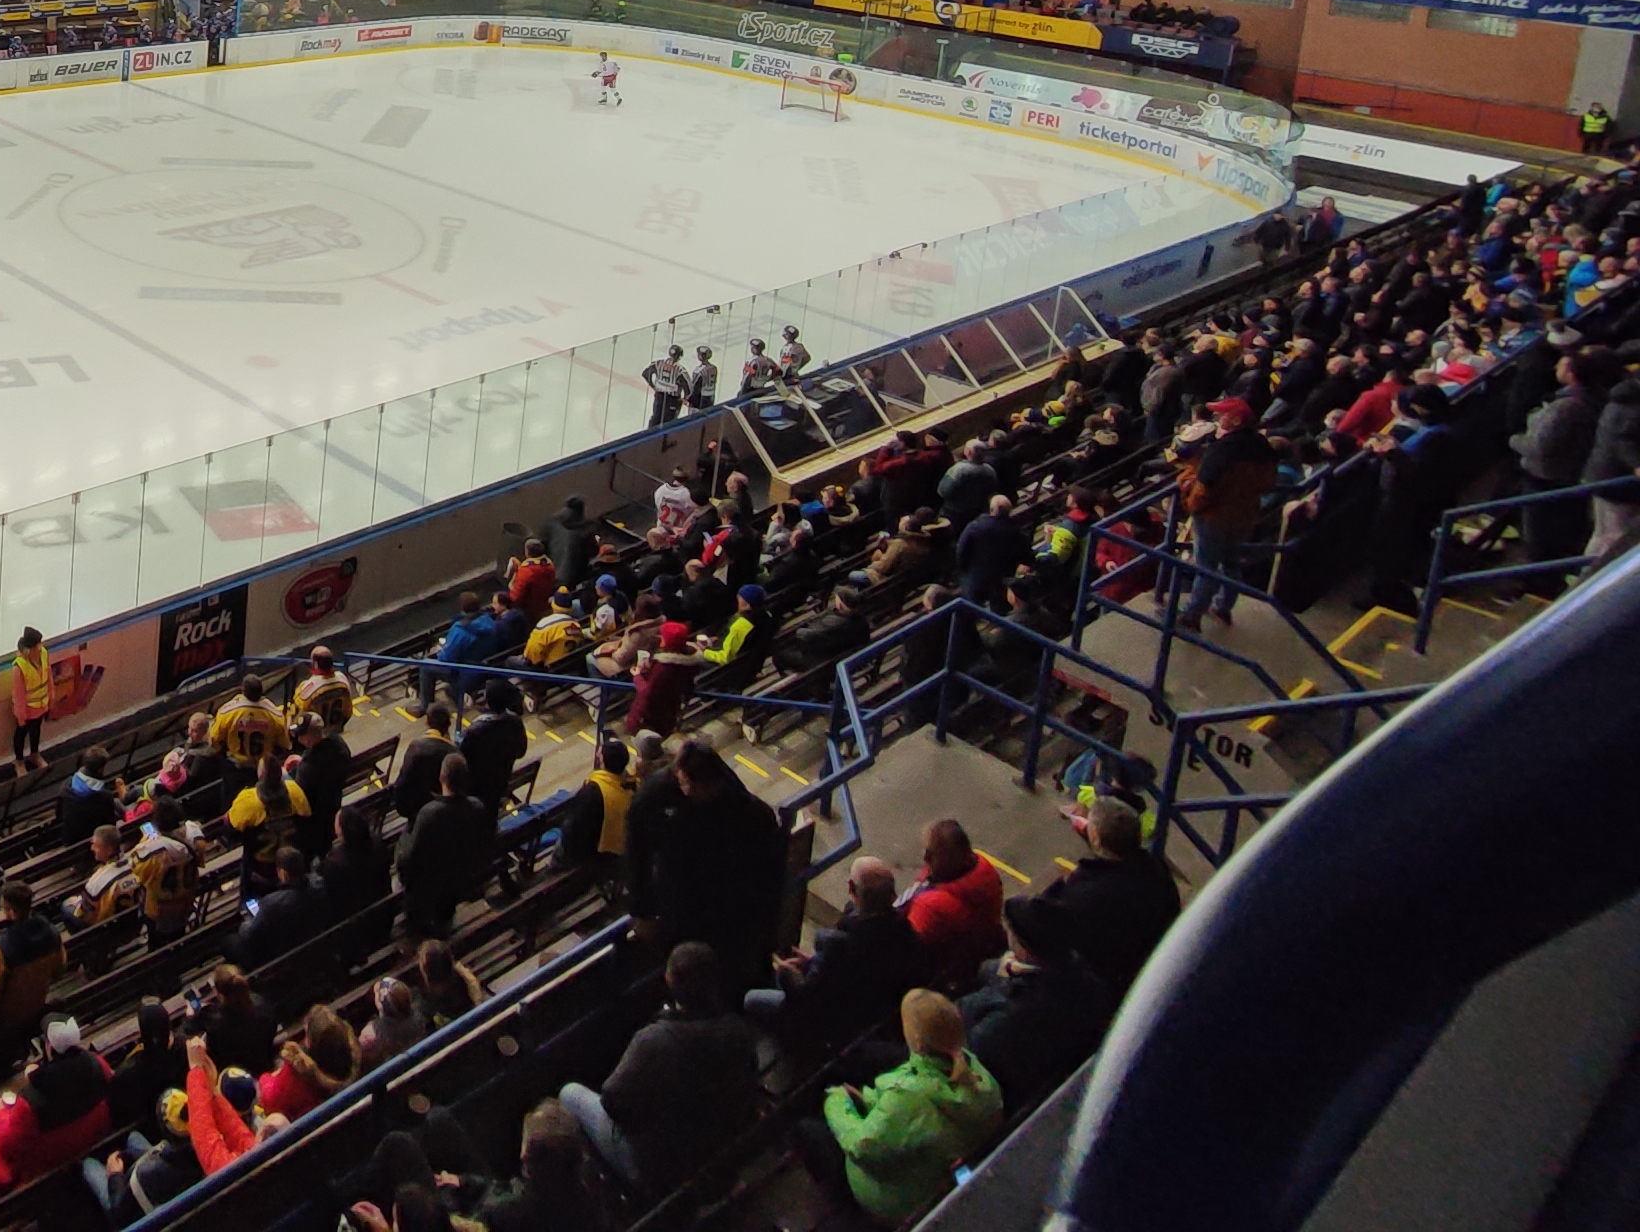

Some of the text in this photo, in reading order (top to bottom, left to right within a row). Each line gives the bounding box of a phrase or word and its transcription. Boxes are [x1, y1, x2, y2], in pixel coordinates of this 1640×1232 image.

[502, 26, 571, 42] RADEGAST
[738, 11, 833, 49] iSport.cz
[55, 59, 119, 76] BAUER
[753, 54, 791, 69] SEVEN
[751, 63, 797, 80] ENERGY
[987, 74, 1043, 95] Noventis
[1027, 110, 1060, 128] PERI
[1078, 121, 1178, 161] ticketportal
[660, 504, 683, 526] 27
[174, 606, 234, 650] Rock
